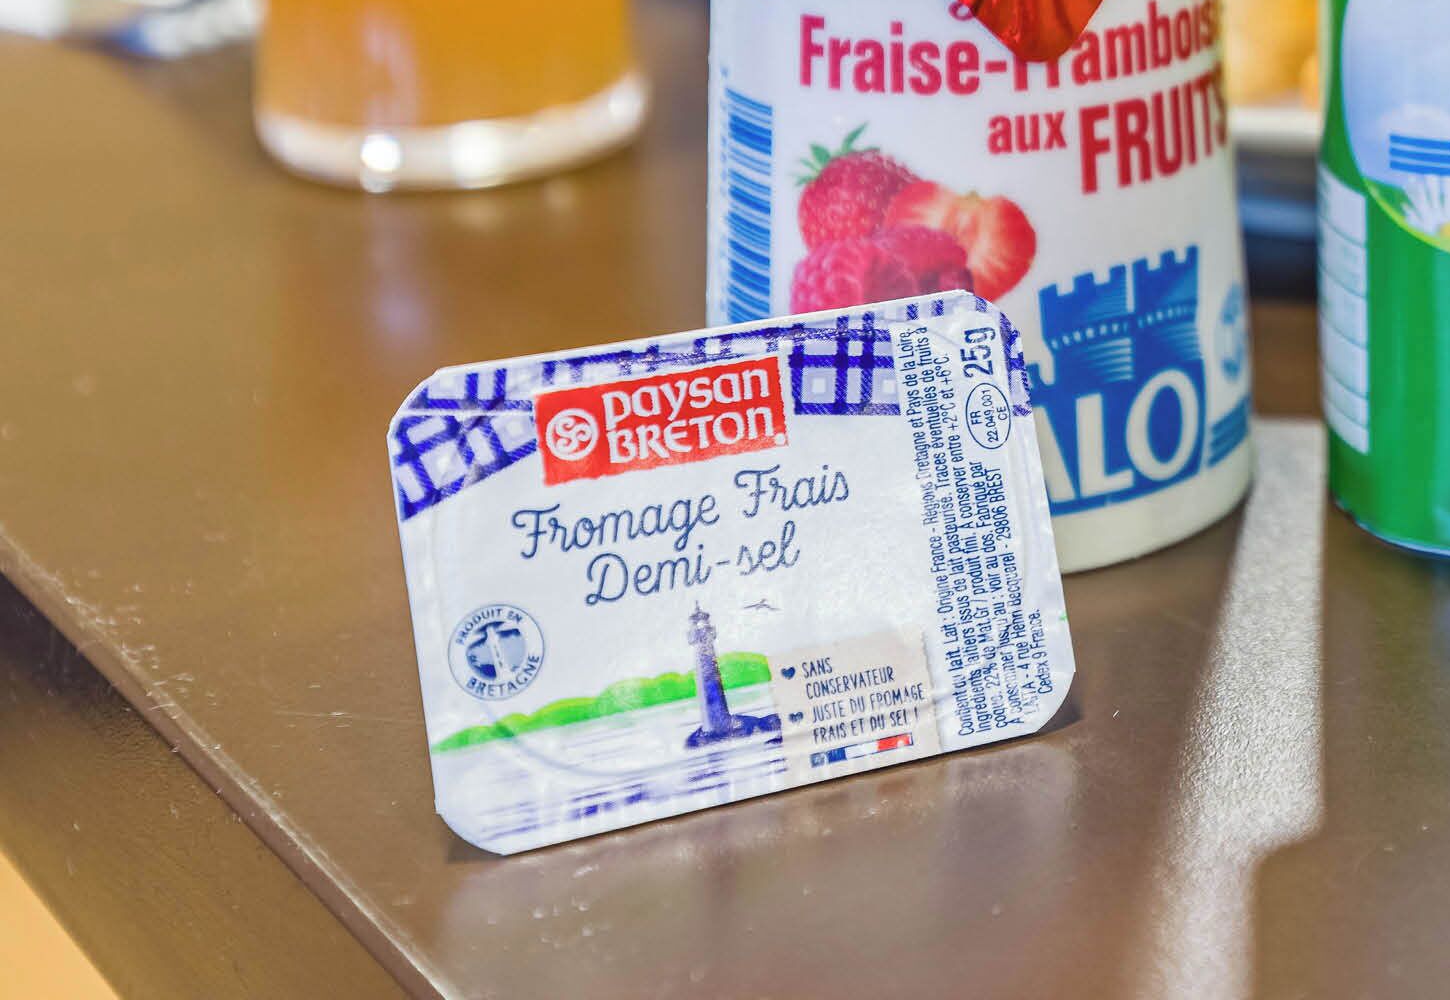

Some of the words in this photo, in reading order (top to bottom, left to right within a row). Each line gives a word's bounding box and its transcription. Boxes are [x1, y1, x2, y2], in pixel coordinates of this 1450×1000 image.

[987, 111, 1067, 155] aux
[895, 328, 914, 358] Loire.
[916, 336, 932, 366] fruits
[959, 326, 997, 378] 25g
[900, 360, 916, 371] la
[903, 373, 918, 387] de
[920, 368, 935, 383] de
[905, 388, 925, 415] Pays
[939, 387, 954, 399] et
[909, 416, 924, 428] et
[922, 385, 945, 449] éventuelles
[969, 410, 982, 424] FR
[996, 406, 1007, 420] CE
[947, 434, 963, 463] entre
[1033, 369, 1199, 504] ALO
[934, 451, 950, 489] Traces
[970, 459, 987, 478] par
[953, 465, 973, 519] conserver
[986, 467, 1005, 503] BREST
[511, 494, 721, 560] Fromage
[733, 463, 850, 519] Frais
[970, 479, 996, 528] Fabriqué
[992, 504, 1011, 540] 29806
[930, 535, 947, 573] France
[961, 531, 978, 554] fini.
[981, 530, 996, 553] dos.
[583, 519, 801, 607] Demi-sel
[948, 556, 964, 575] lait
[965, 554, 988, 595] produit
[984, 554, 999, 569] au
[935, 574, 955, 614] Origine
[987, 572, 1002, 593] voir
[957, 594, 973, 625] issus
[1009, 608, 1027, 638] Henri
[941, 622, 958, 644] Lait
[1014, 641, 1030, 660] rue
[1031, 650, 1047, 659] 9
[465, 655, 540, 697] BRETAGNE
[801, 657, 834, 679] SANS
[1016, 662, 1031, 670] 4
[805, 665, 896, 700] CONSERVATEUR
[811, 700, 848, 724] JUSTE
[849, 695, 866, 715] DU
[869, 682, 926, 710] FROMAGE
[812, 721, 848, 745] FRAIS
[850, 717, 865, 737] ET
[869, 714, 886, 732] DU
